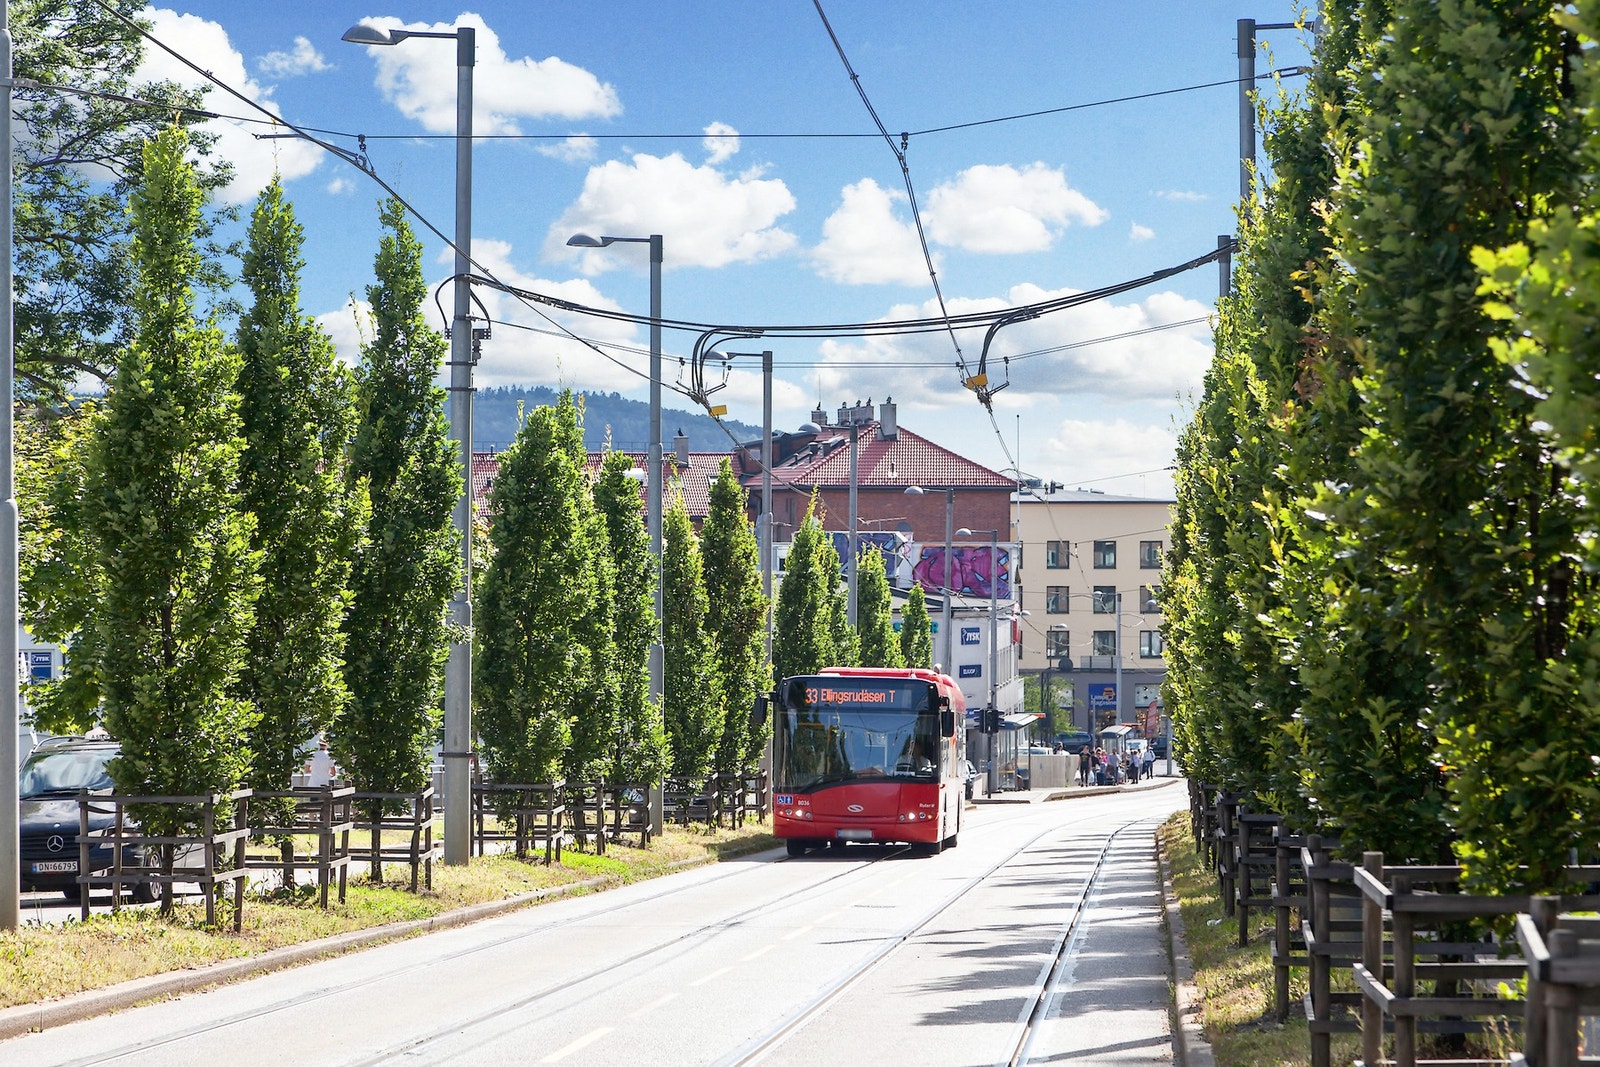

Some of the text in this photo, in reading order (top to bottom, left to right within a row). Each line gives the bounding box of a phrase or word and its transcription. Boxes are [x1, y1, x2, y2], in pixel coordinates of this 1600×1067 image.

[966, 632, 980, 641] JYSK
[805, 688, 896, 705] 33 Ellingsrudåsen T
